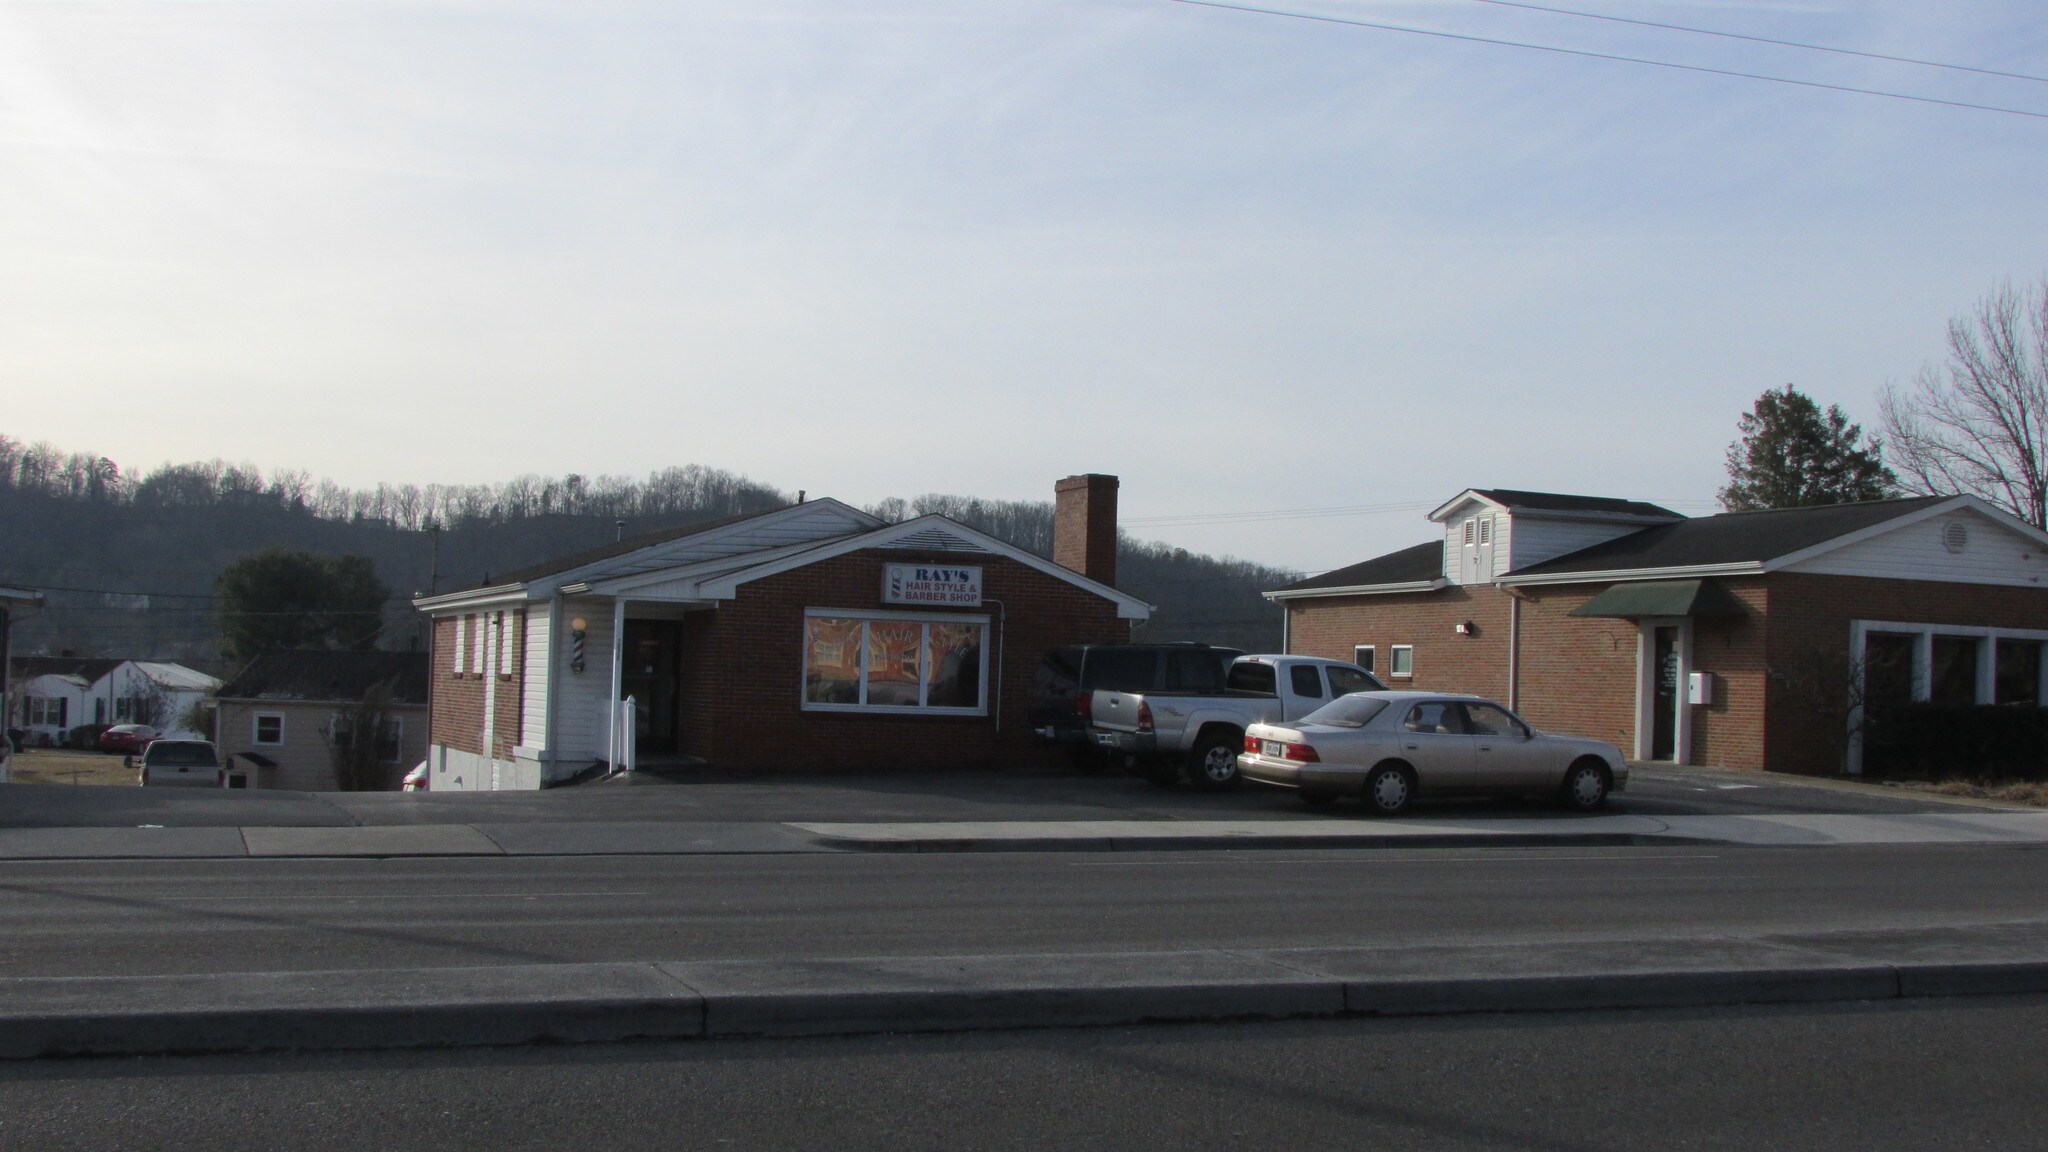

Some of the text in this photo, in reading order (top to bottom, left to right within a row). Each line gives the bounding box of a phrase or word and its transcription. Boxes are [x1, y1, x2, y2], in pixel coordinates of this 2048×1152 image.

[915, 568, 969, 583] RAY'S
[906, 582, 977, 593] HAIR STYLE &
[905, 591, 977, 602] BARBER SHOP
[876, 628, 912, 643] HAIR
